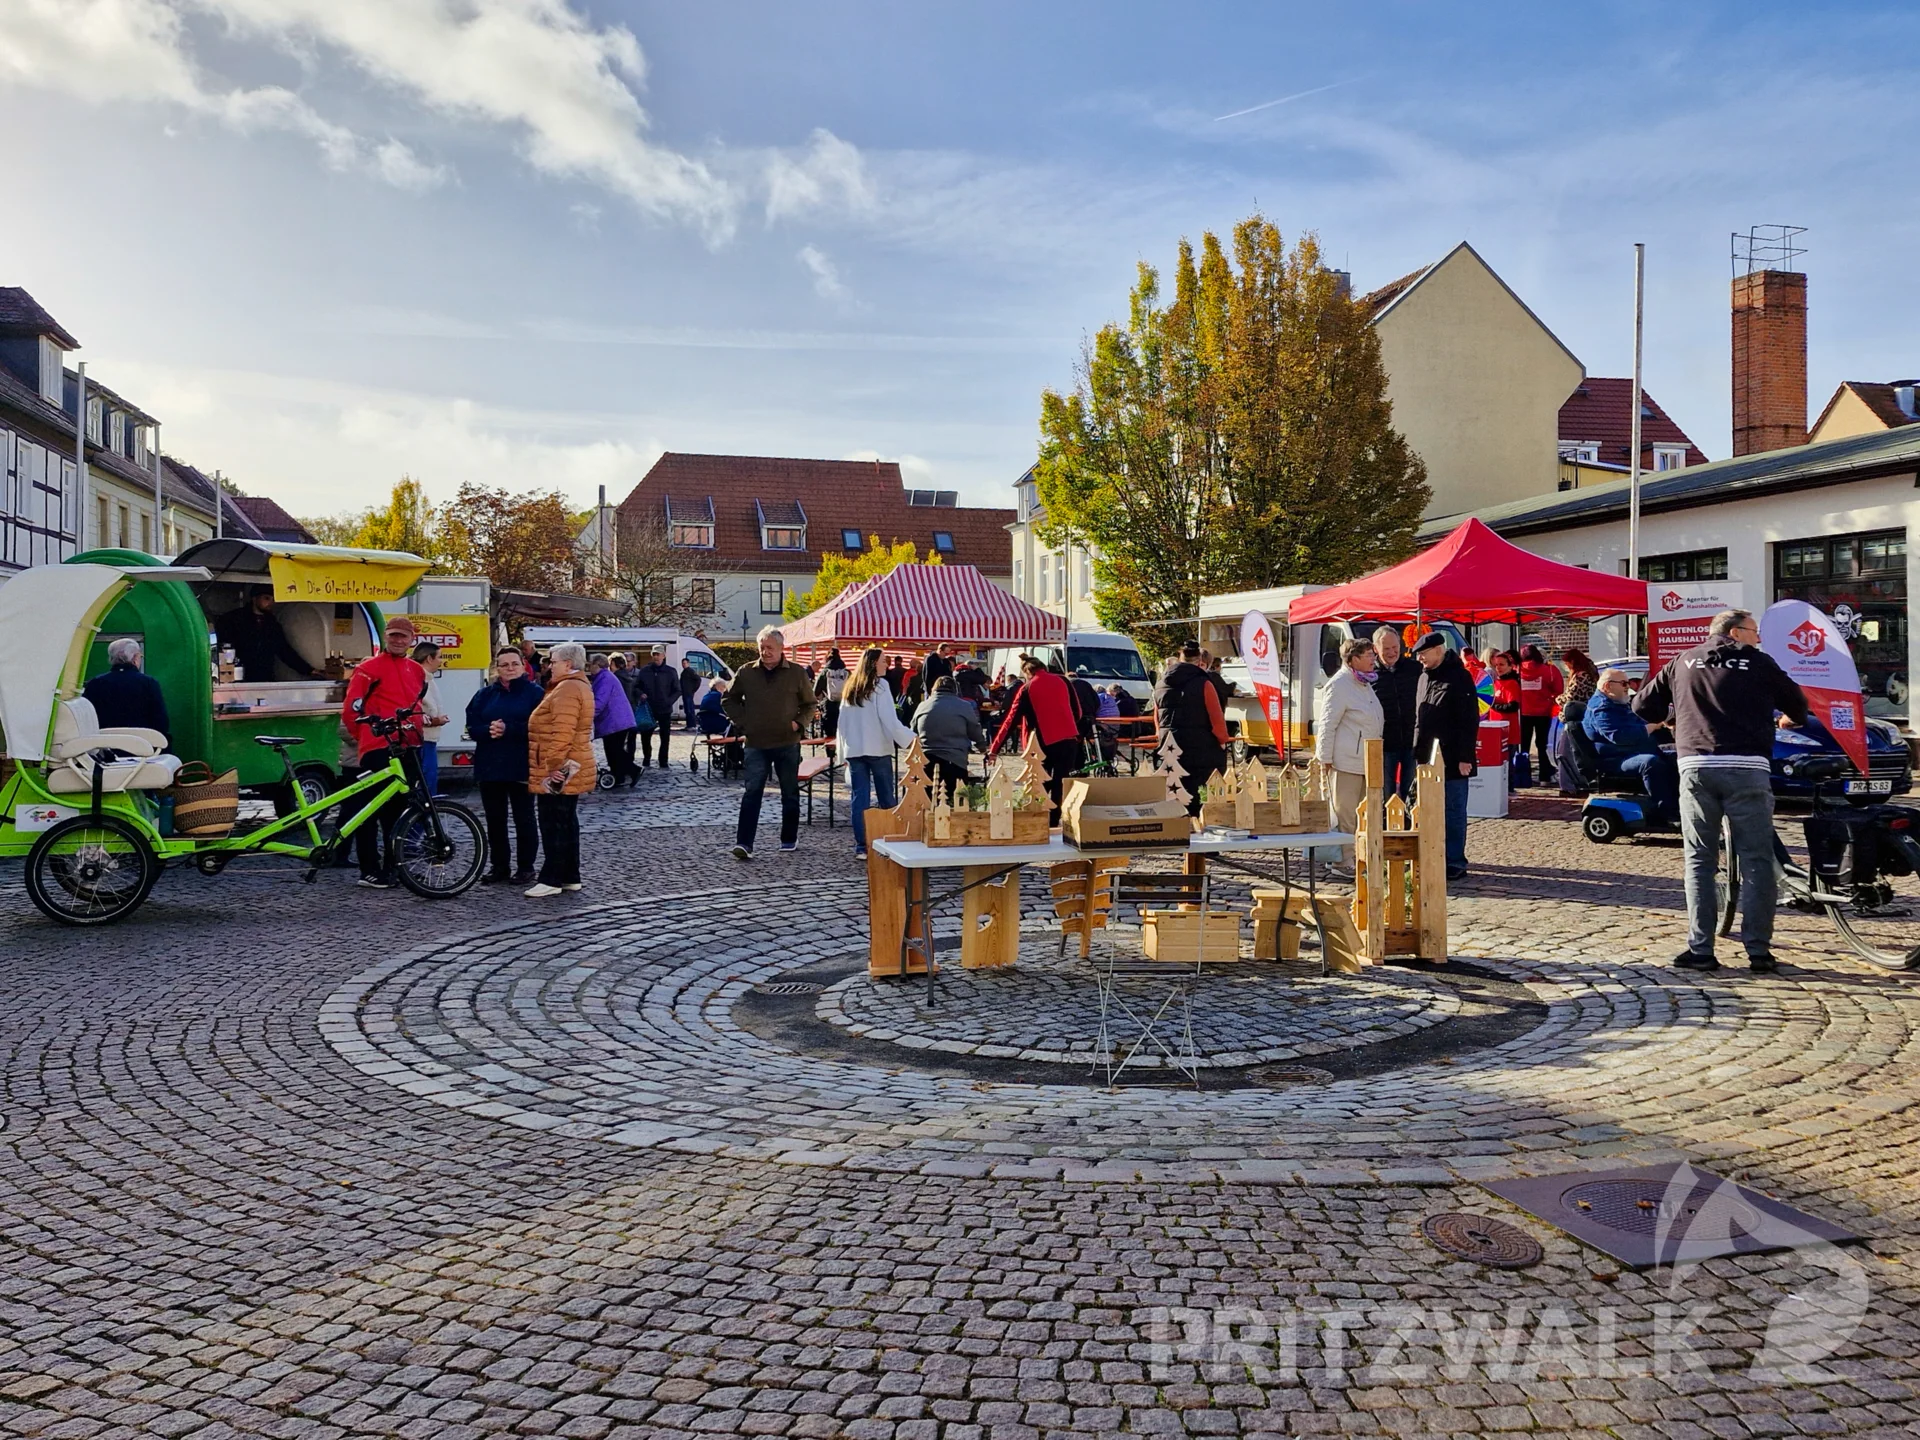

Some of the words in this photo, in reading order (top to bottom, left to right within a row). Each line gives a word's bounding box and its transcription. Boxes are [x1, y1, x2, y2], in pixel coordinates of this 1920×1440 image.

[307, 580, 321, 595] Die
[325, 576, 360, 596] Ölmühle
[408, 615, 456, 629] WURSTWAREN
